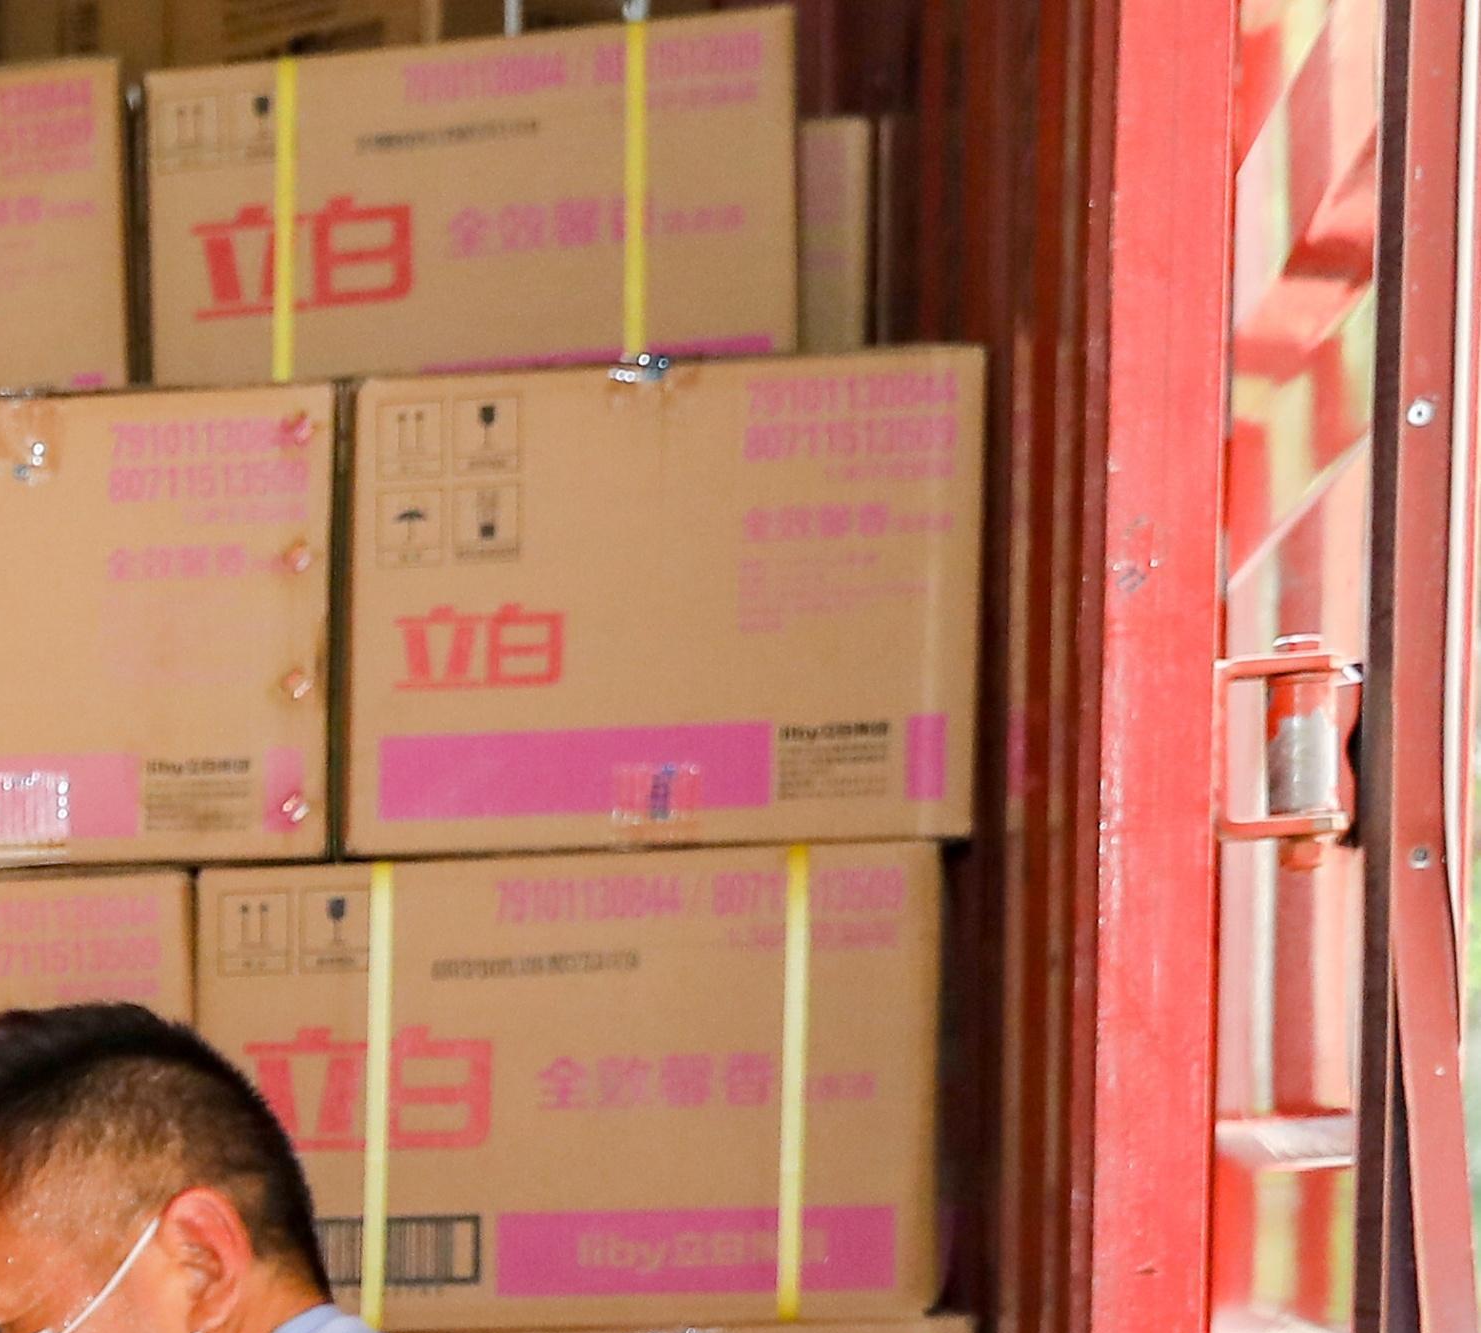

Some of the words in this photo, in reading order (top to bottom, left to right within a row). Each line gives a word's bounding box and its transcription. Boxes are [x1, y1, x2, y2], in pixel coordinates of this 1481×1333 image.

[194, 195, 414, 319] 立白
[398, 603, 565, 689] 立白
[244, 1025, 494, 1152] 立白
